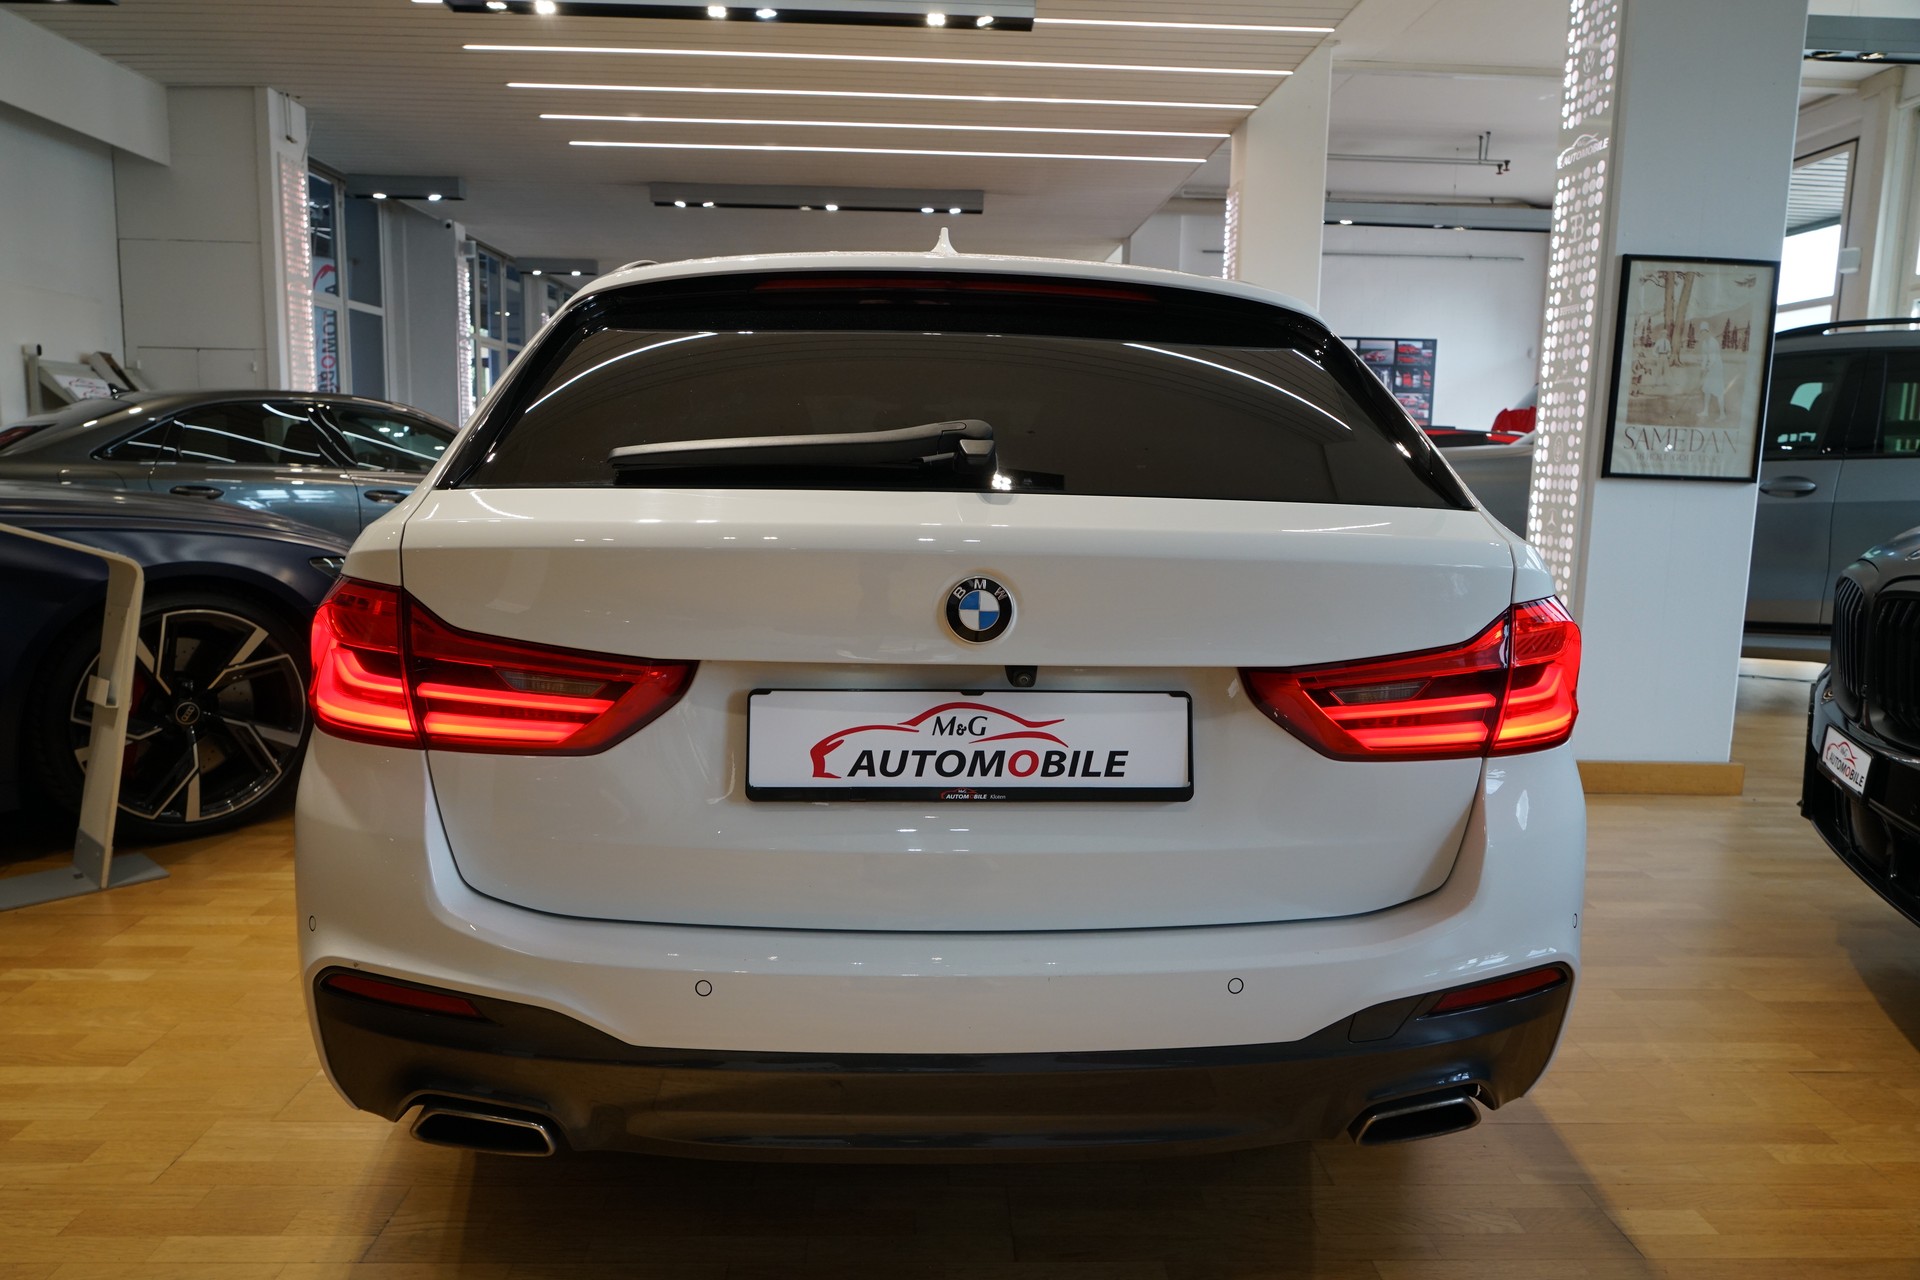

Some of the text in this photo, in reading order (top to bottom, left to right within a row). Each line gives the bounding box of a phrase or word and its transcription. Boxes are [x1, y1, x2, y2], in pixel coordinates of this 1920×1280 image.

[1623, 426, 1739, 453] SAMEDAN
[953, 579, 1008, 600] BMW
[932, 716, 988, 736] M&G
[847, 749, 1129, 778] AUTOMOBILE
[1829, 752, 1865, 787] AUTOMOBILE
